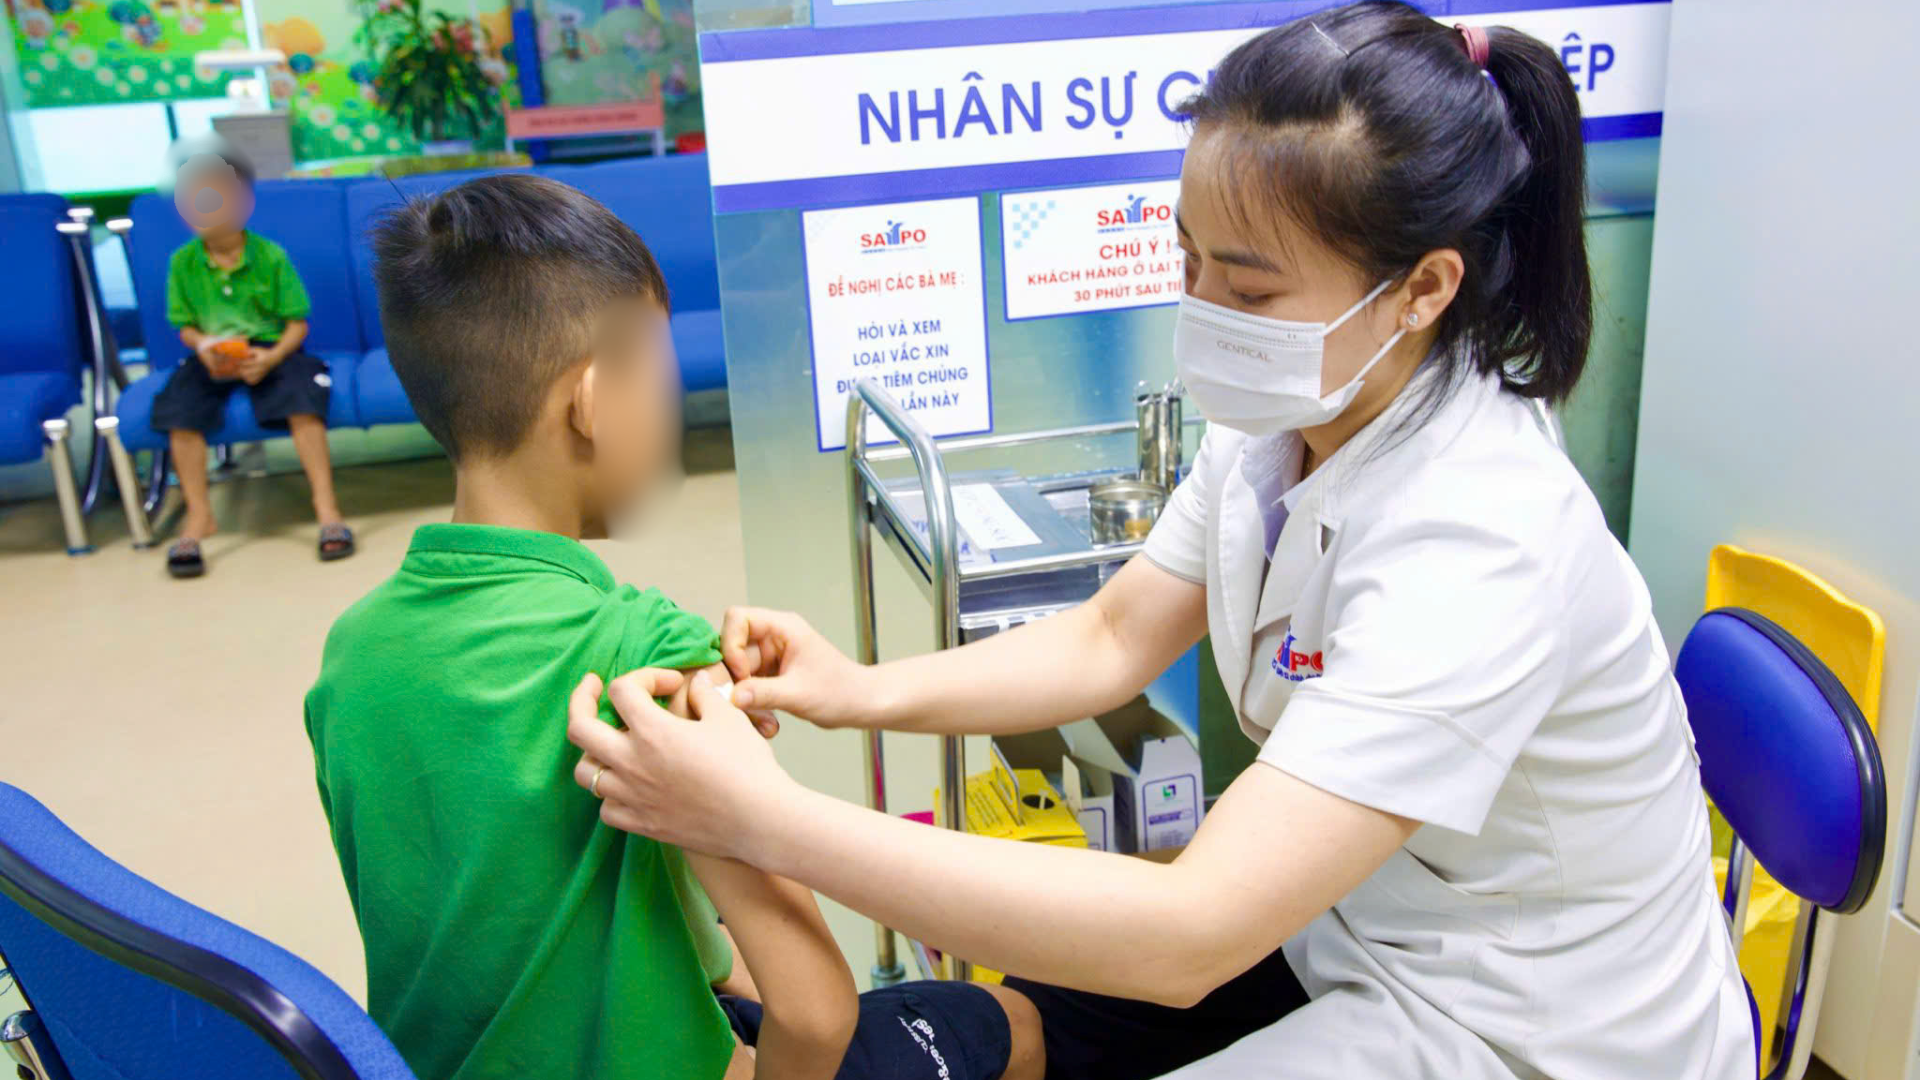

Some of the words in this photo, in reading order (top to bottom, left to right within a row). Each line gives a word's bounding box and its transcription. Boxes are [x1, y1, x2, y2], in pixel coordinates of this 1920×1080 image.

[857, 71, 1043, 145] NHÂN
[1065, 70, 1137, 140] SỰ
[1099, 237, 1141, 260] CHÚ
[1148, 236, 1159, 255] Ý
[849, 278, 882, 297] NGHỊ
[885, 273, 915, 291] CÁC
[919, 269, 936, 288] BÀ
[940, 271, 957, 290] MẸ
[1027, 268, 1081, 285] KHÁCH
[1085, 264, 1128, 281] HÀNG
[1074, 289, 1091, 302] 30
[1096, 284, 1131, 300] PHÚT
[1135, 283, 1161, 297] SAU
[858, 321, 884, 341] HỎI
[888, 319, 908, 337] VÀ
[912, 319, 942, 335] XEM
[853, 351, 886, 368] LOẠI
[890, 341, 920, 362] VẮC
[925, 344, 950, 359] XIN
[883, 370, 913, 388] TIÊM
[932, 389, 960, 407] NÀY
